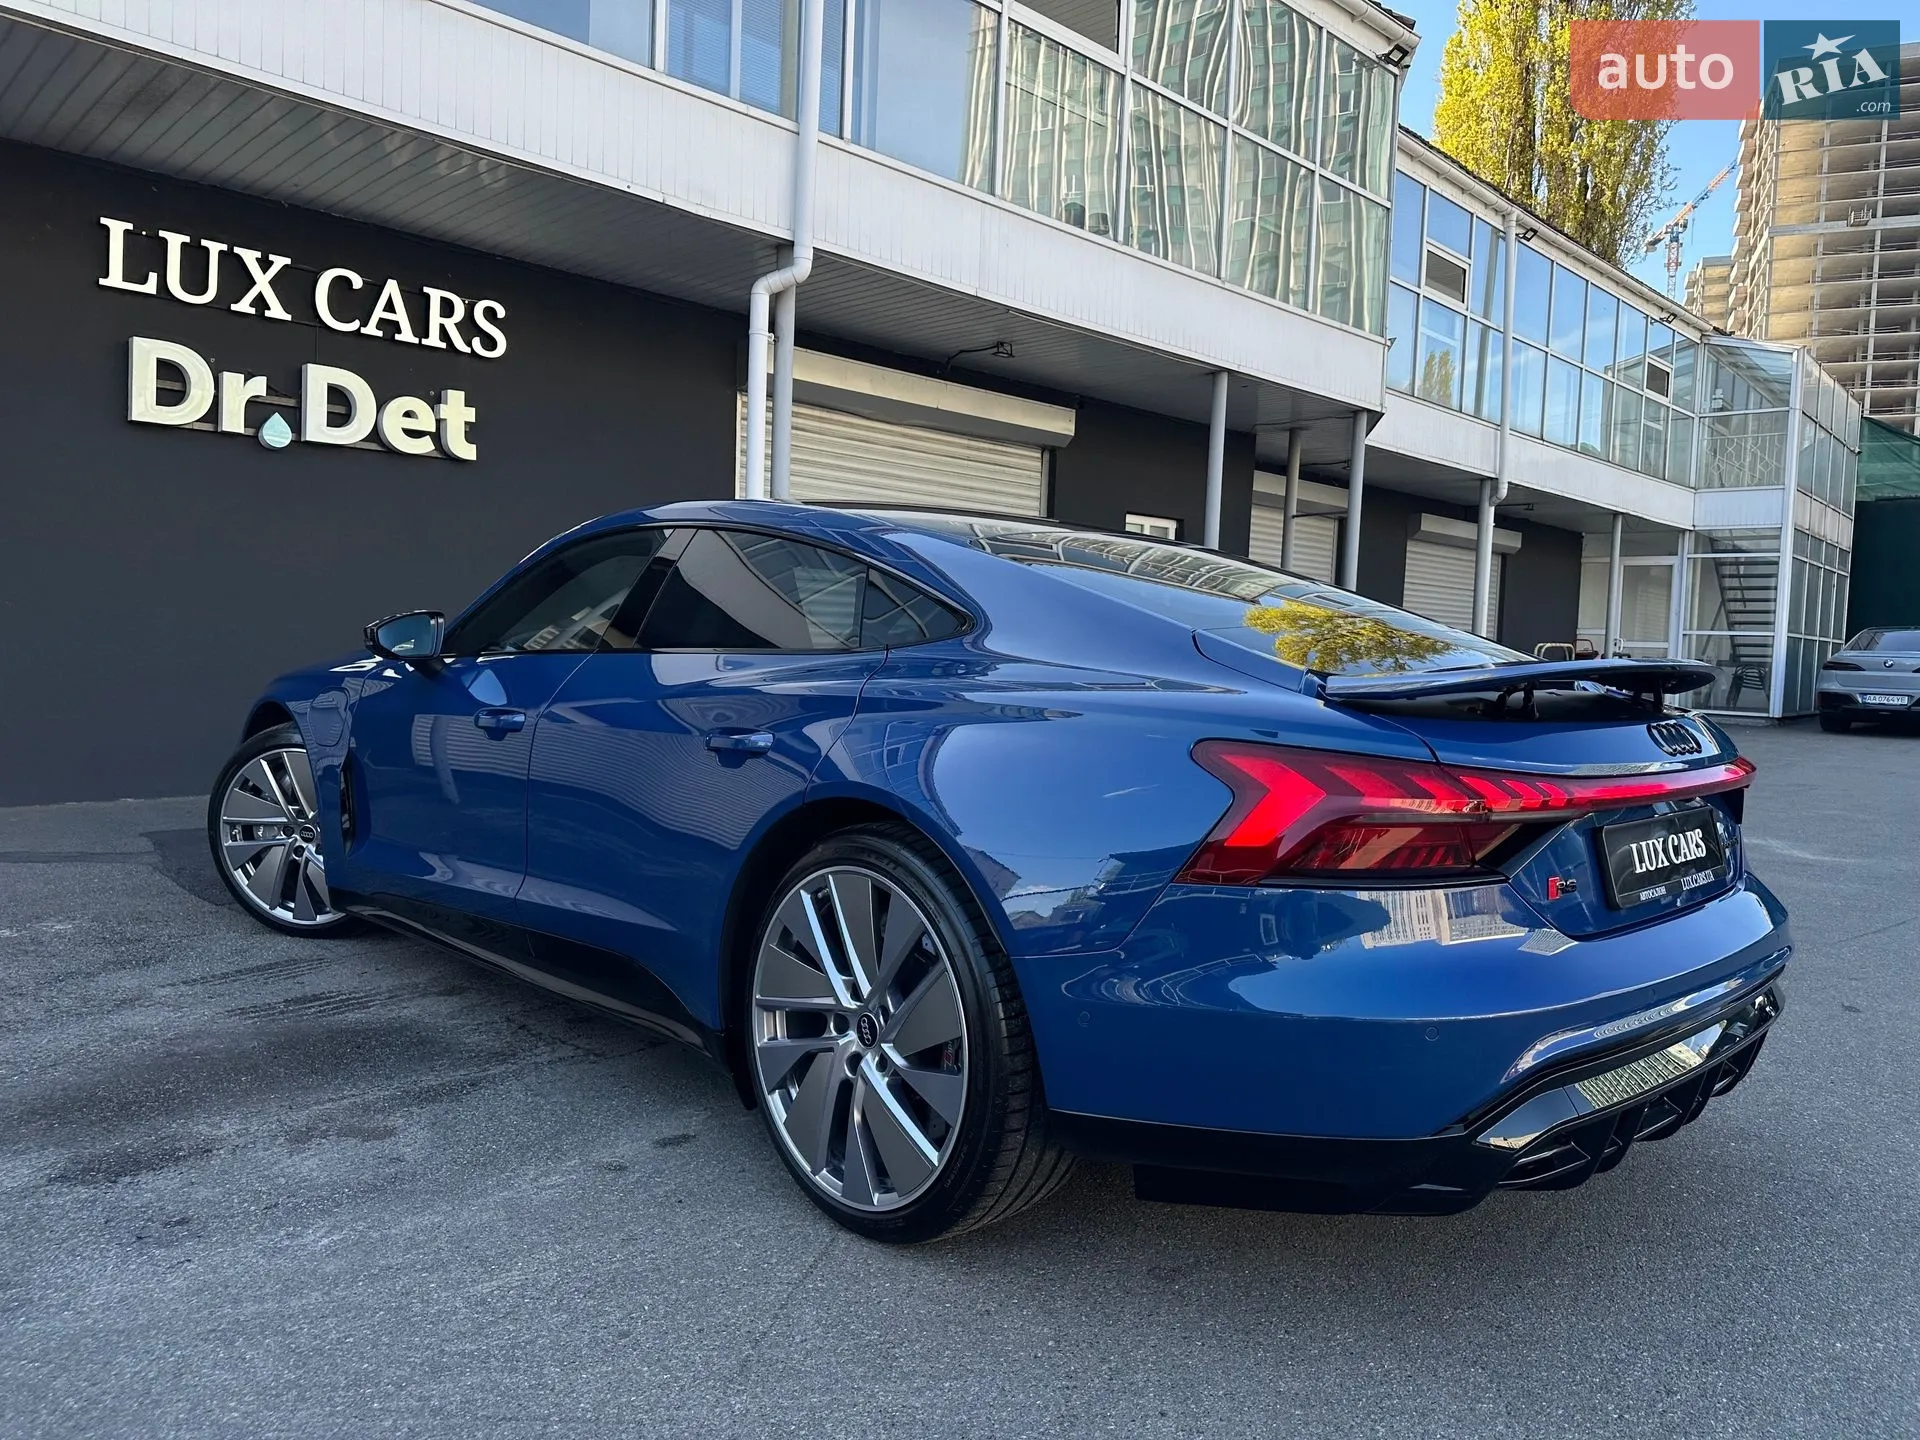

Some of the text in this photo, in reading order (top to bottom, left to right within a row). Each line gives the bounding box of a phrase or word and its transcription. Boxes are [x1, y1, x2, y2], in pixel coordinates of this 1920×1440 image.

[98, 216, 507, 359] LUX CARS
[1629, 828, 1707, 874] LUX CARS
